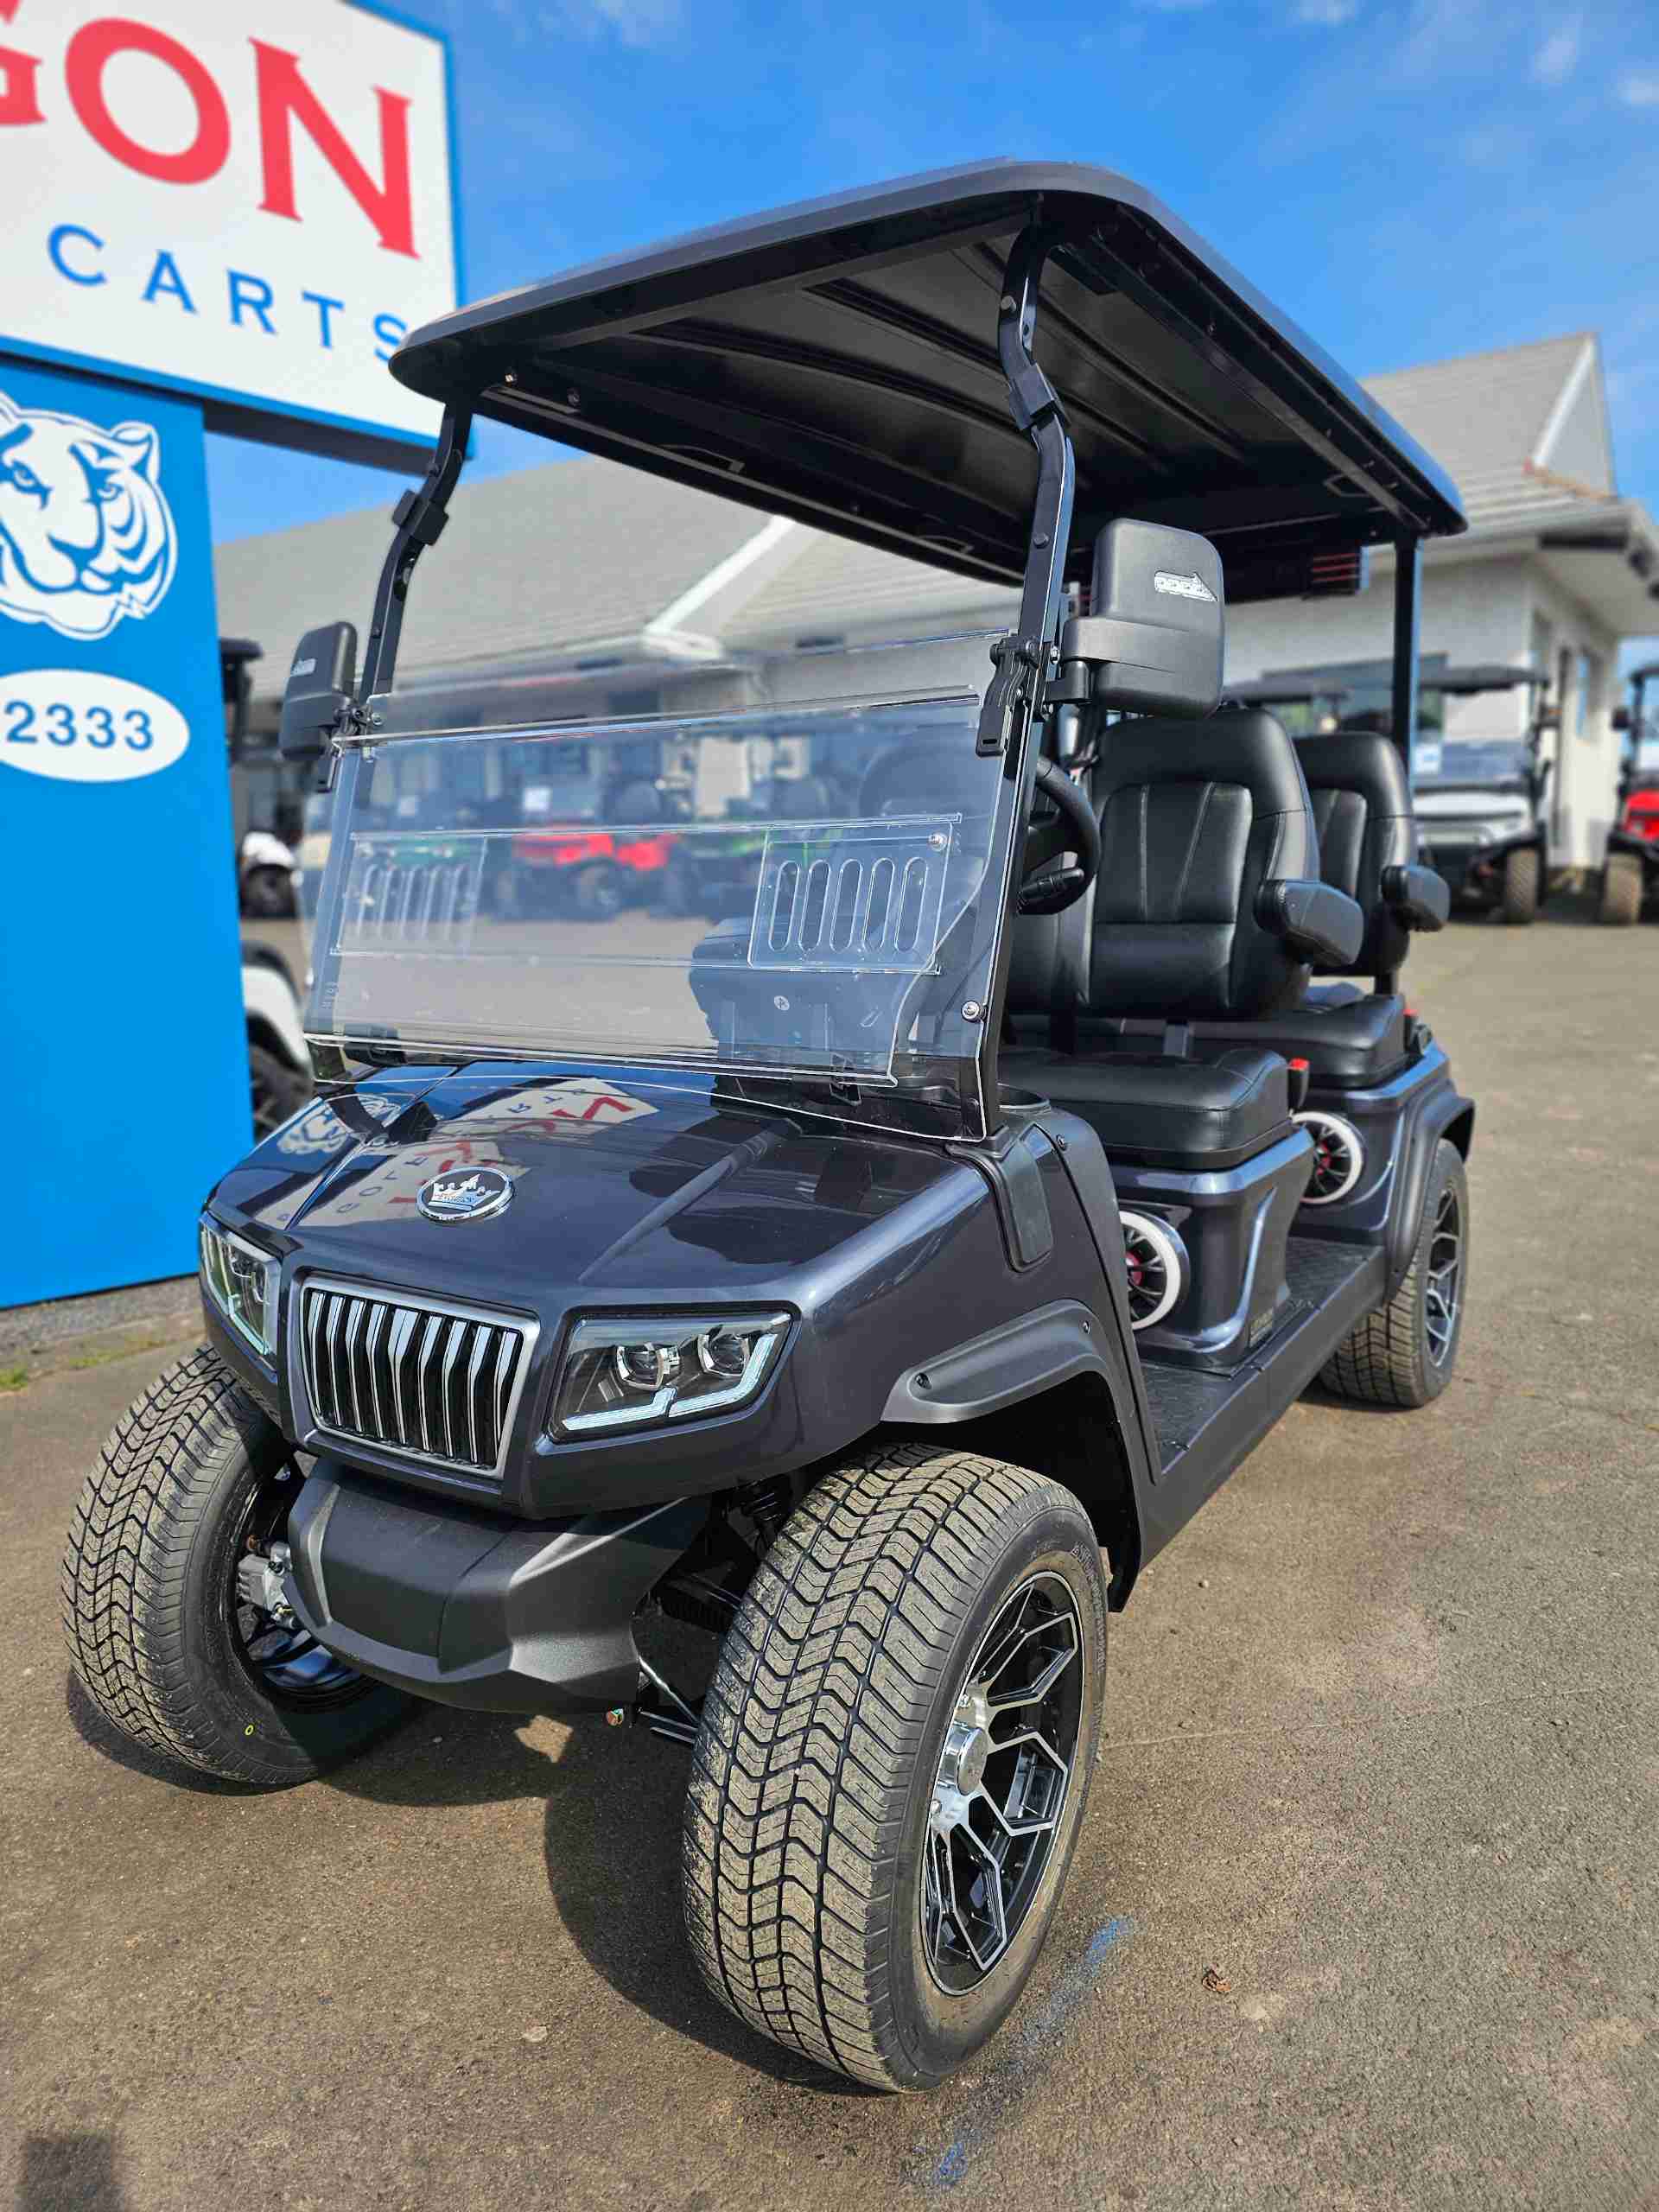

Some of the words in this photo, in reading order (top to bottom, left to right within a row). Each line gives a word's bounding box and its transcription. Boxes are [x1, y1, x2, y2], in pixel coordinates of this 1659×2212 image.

[0, 0, 420, 260] ON
[47, 223, 408, 365] CARTS
[4, 700, 155, 752] 2333
